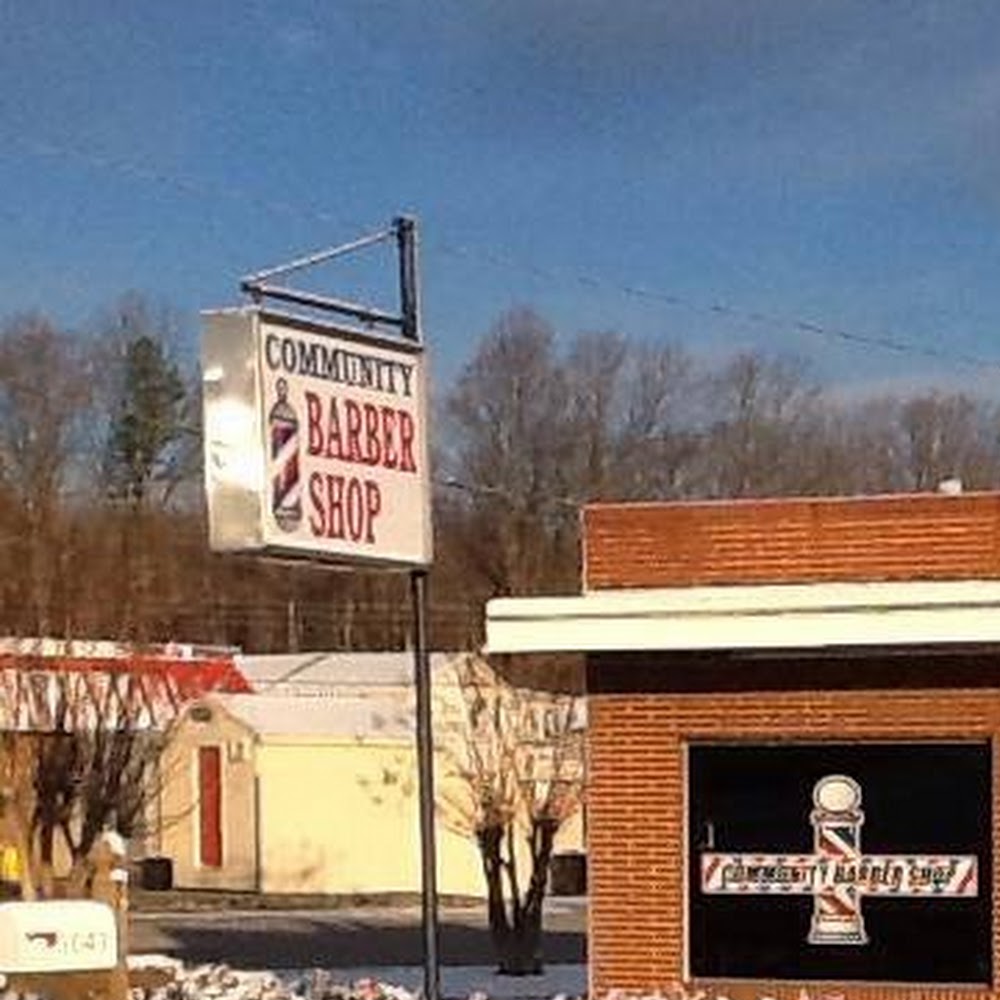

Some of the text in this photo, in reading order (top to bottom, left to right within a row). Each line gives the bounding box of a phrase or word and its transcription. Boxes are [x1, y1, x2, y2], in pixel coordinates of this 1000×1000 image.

[265, 333, 415, 397] COMMUNITY
[305, 391, 418, 473] BARBER
[309, 471, 382, 544] SHOP
